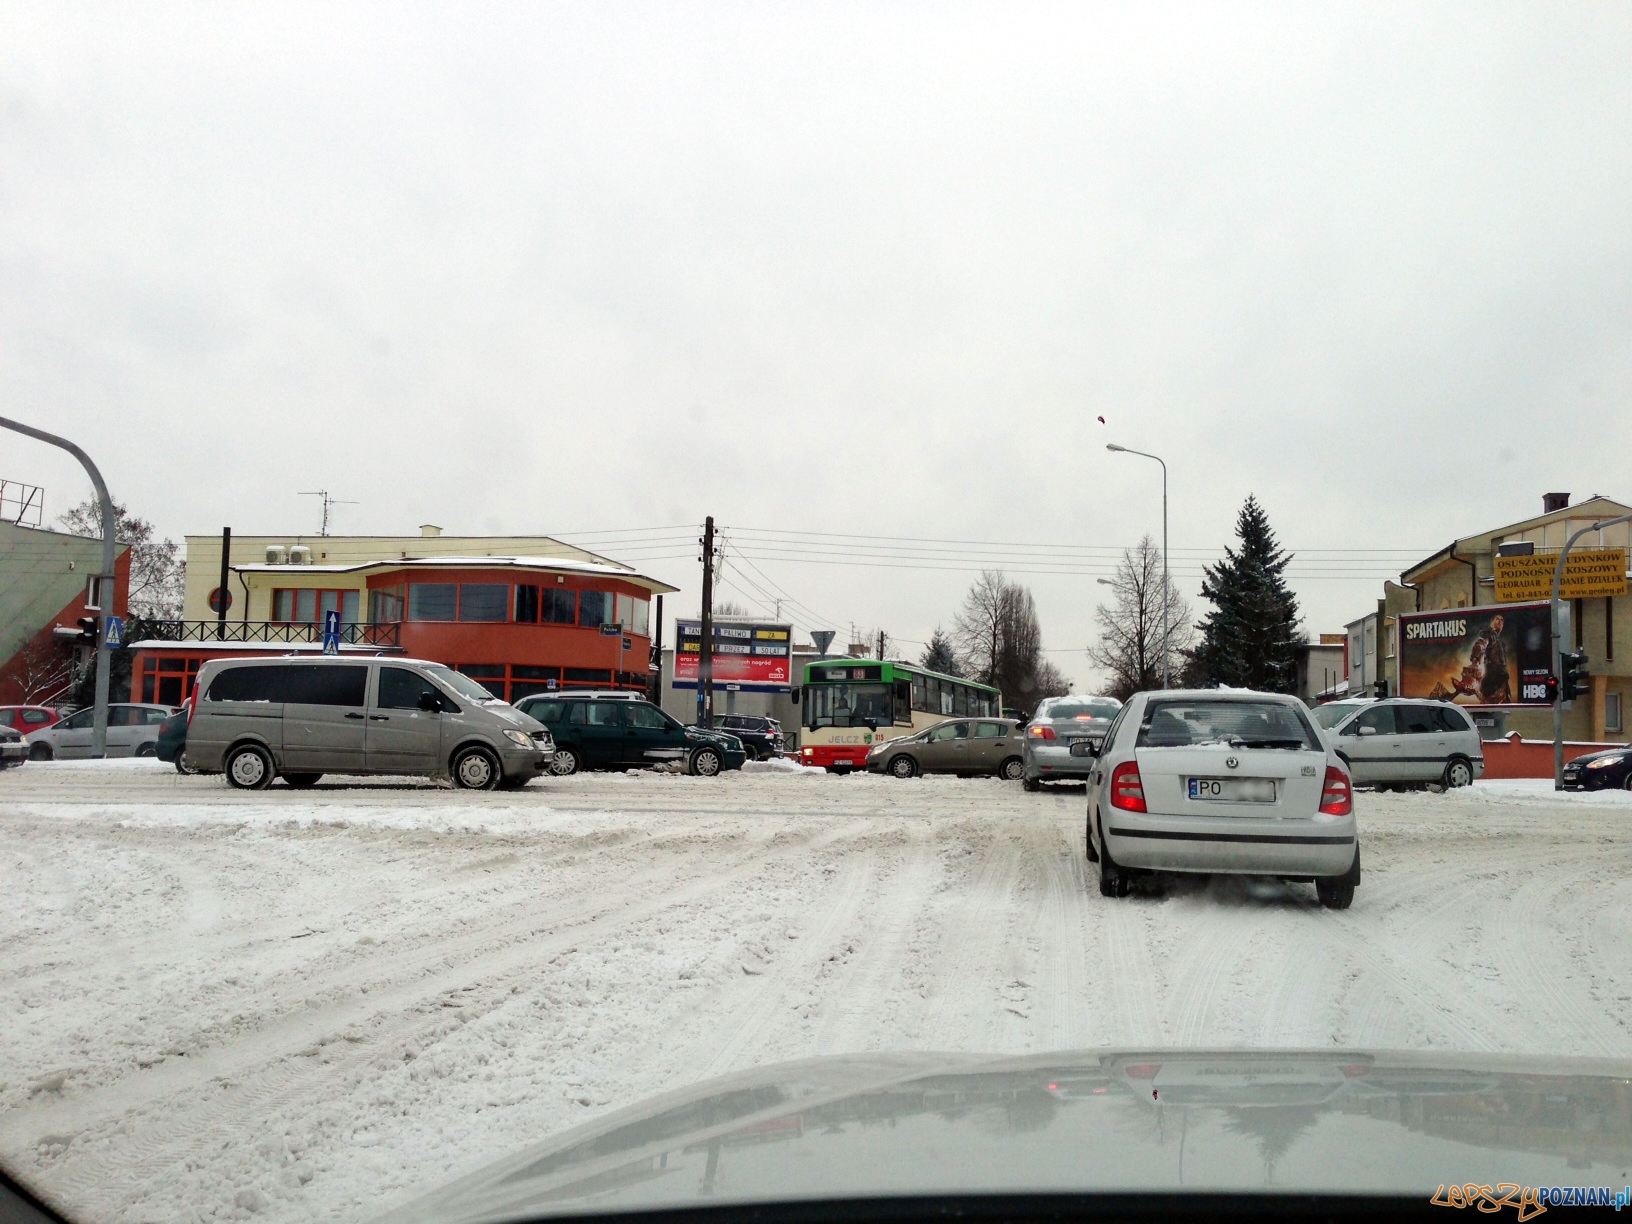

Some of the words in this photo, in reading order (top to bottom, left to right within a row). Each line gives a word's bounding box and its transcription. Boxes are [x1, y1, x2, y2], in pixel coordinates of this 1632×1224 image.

[1497, 557, 1557, 569] OSUSZANIE
[1500, 566, 1563, 579] PODNOŚNI
[1566, 564, 1619, 575] KOSZOWY
[1497, 579, 1541, 589] GEORADAR
[1549, 577, 1586, 586] BDANIE
[723, 629, 747, 638] PALIWO
[767, 631, 776, 639] ZA
[1406, 619, 1467, 640] SPARTAKUS
[724, 645, 745, 653] PRZEZ
[1523, 684, 1546, 698] HBO
[828, 735, 860, 744] JELCZ
[875, 733, 884, 741] 015
[1199, 781, 1222, 795] PO
